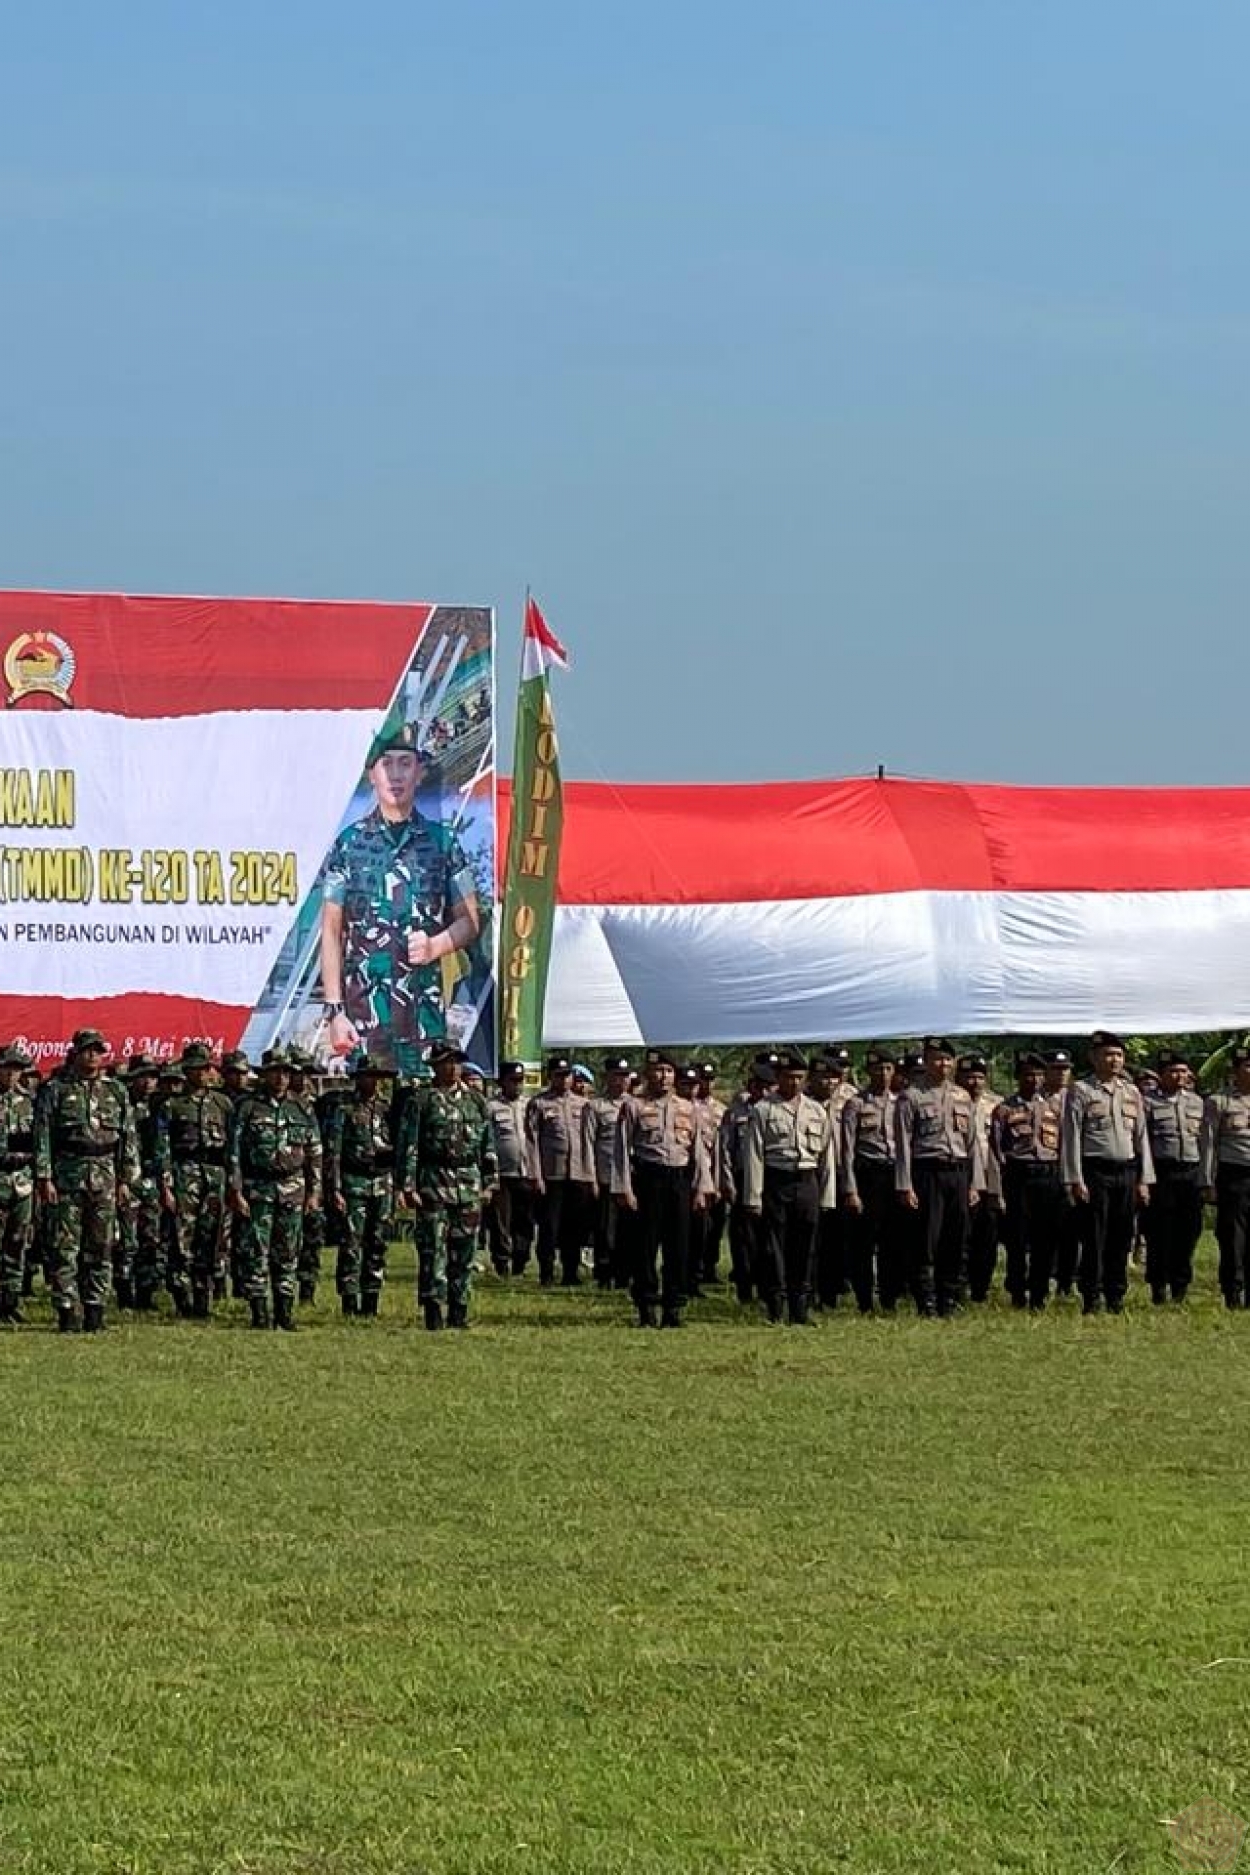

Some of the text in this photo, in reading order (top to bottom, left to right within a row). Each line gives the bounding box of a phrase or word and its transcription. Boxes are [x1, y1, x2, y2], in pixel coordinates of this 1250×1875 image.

[99, 849, 188, 904] KE-120
[193, 850, 225, 905] TA
[229, 851, 298, 905] 2024
[15, 924, 155, 943] PEMBANGUNAN
[162, 925, 179, 943] DI
[184, 925, 272, 944] WILAYAH"
[122, 1036, 136, 1057] 8
